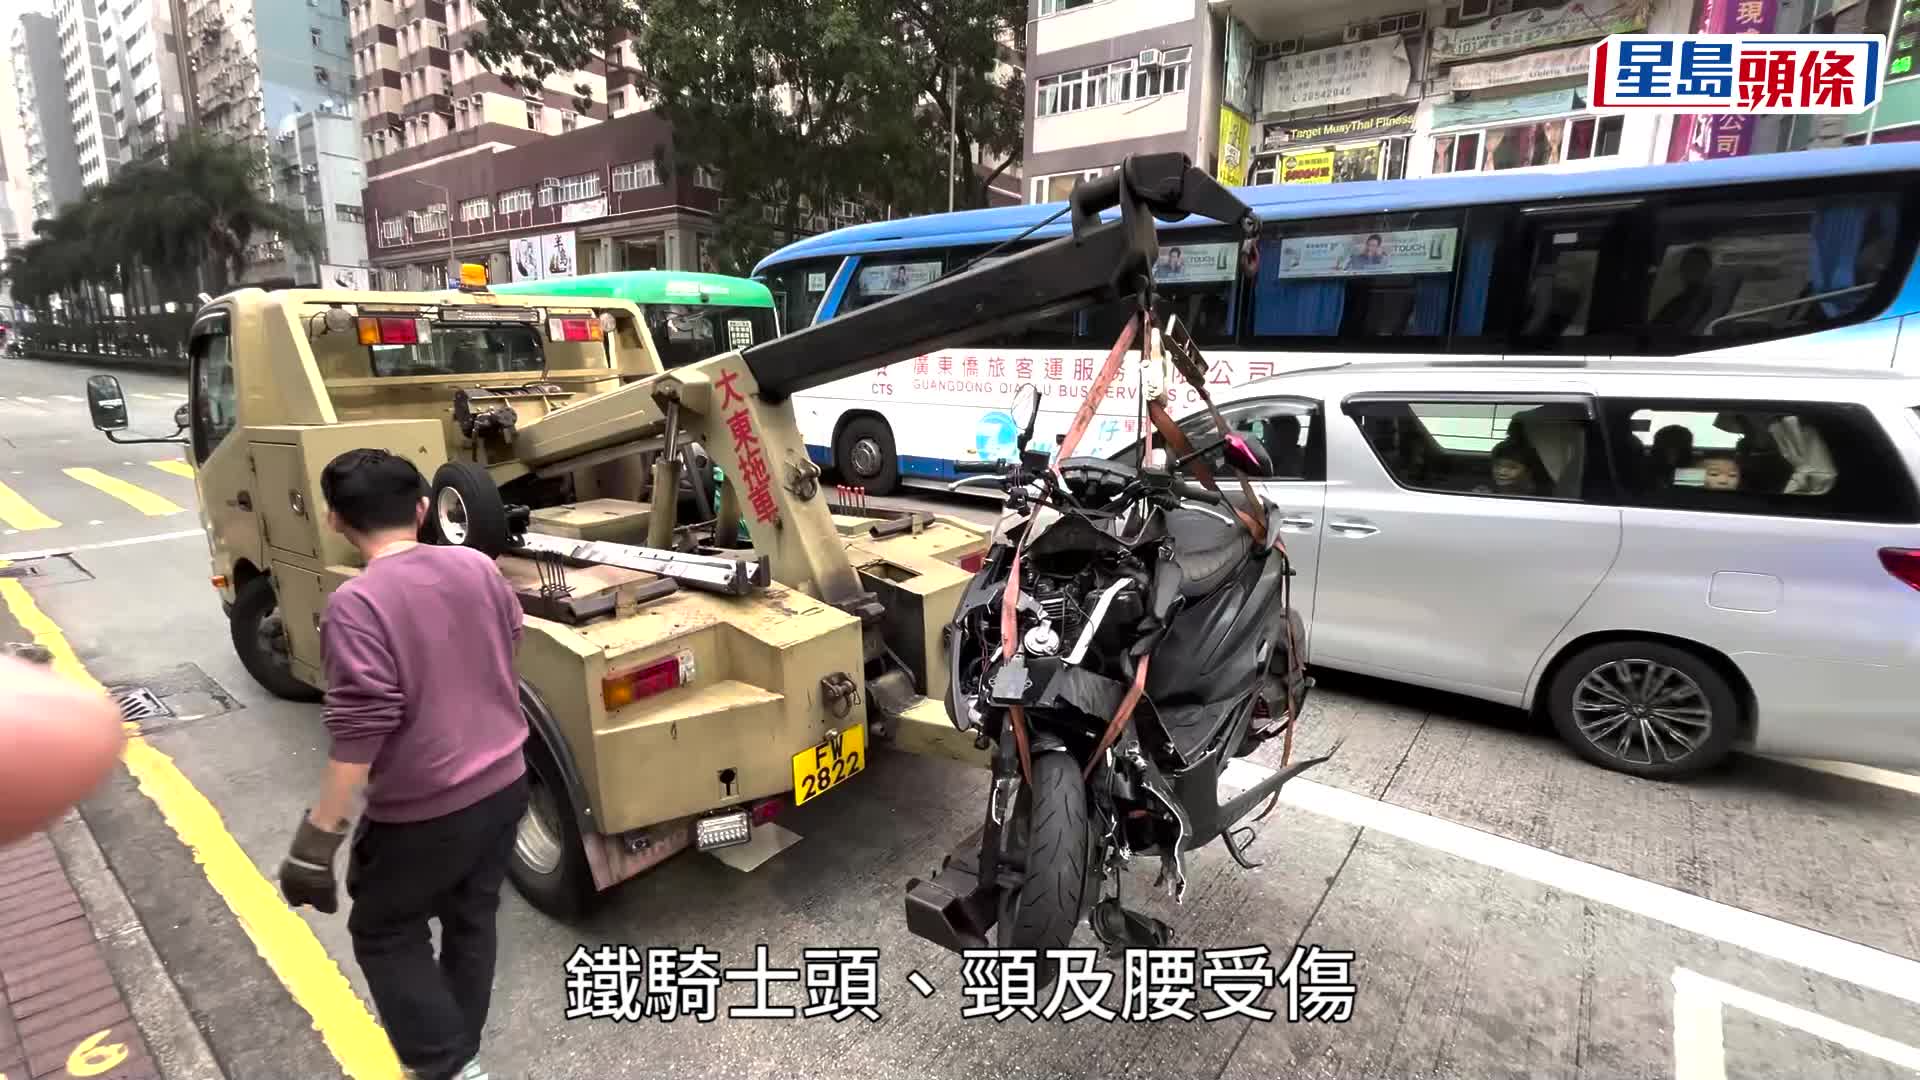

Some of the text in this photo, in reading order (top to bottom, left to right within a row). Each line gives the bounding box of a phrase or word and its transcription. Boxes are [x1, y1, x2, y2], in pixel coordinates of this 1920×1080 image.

[1291, 127, 1322, 140] Target
[871, 383, 894, 396] CTS
[912, 378, 993, 394] GUANGDONG
[1058, 384, 1090, 399] BUS
[714, 368, 780, 524] 大東拖車
[815, 734, 844, 770] FW
[801, 751, 861, 801] 2822
